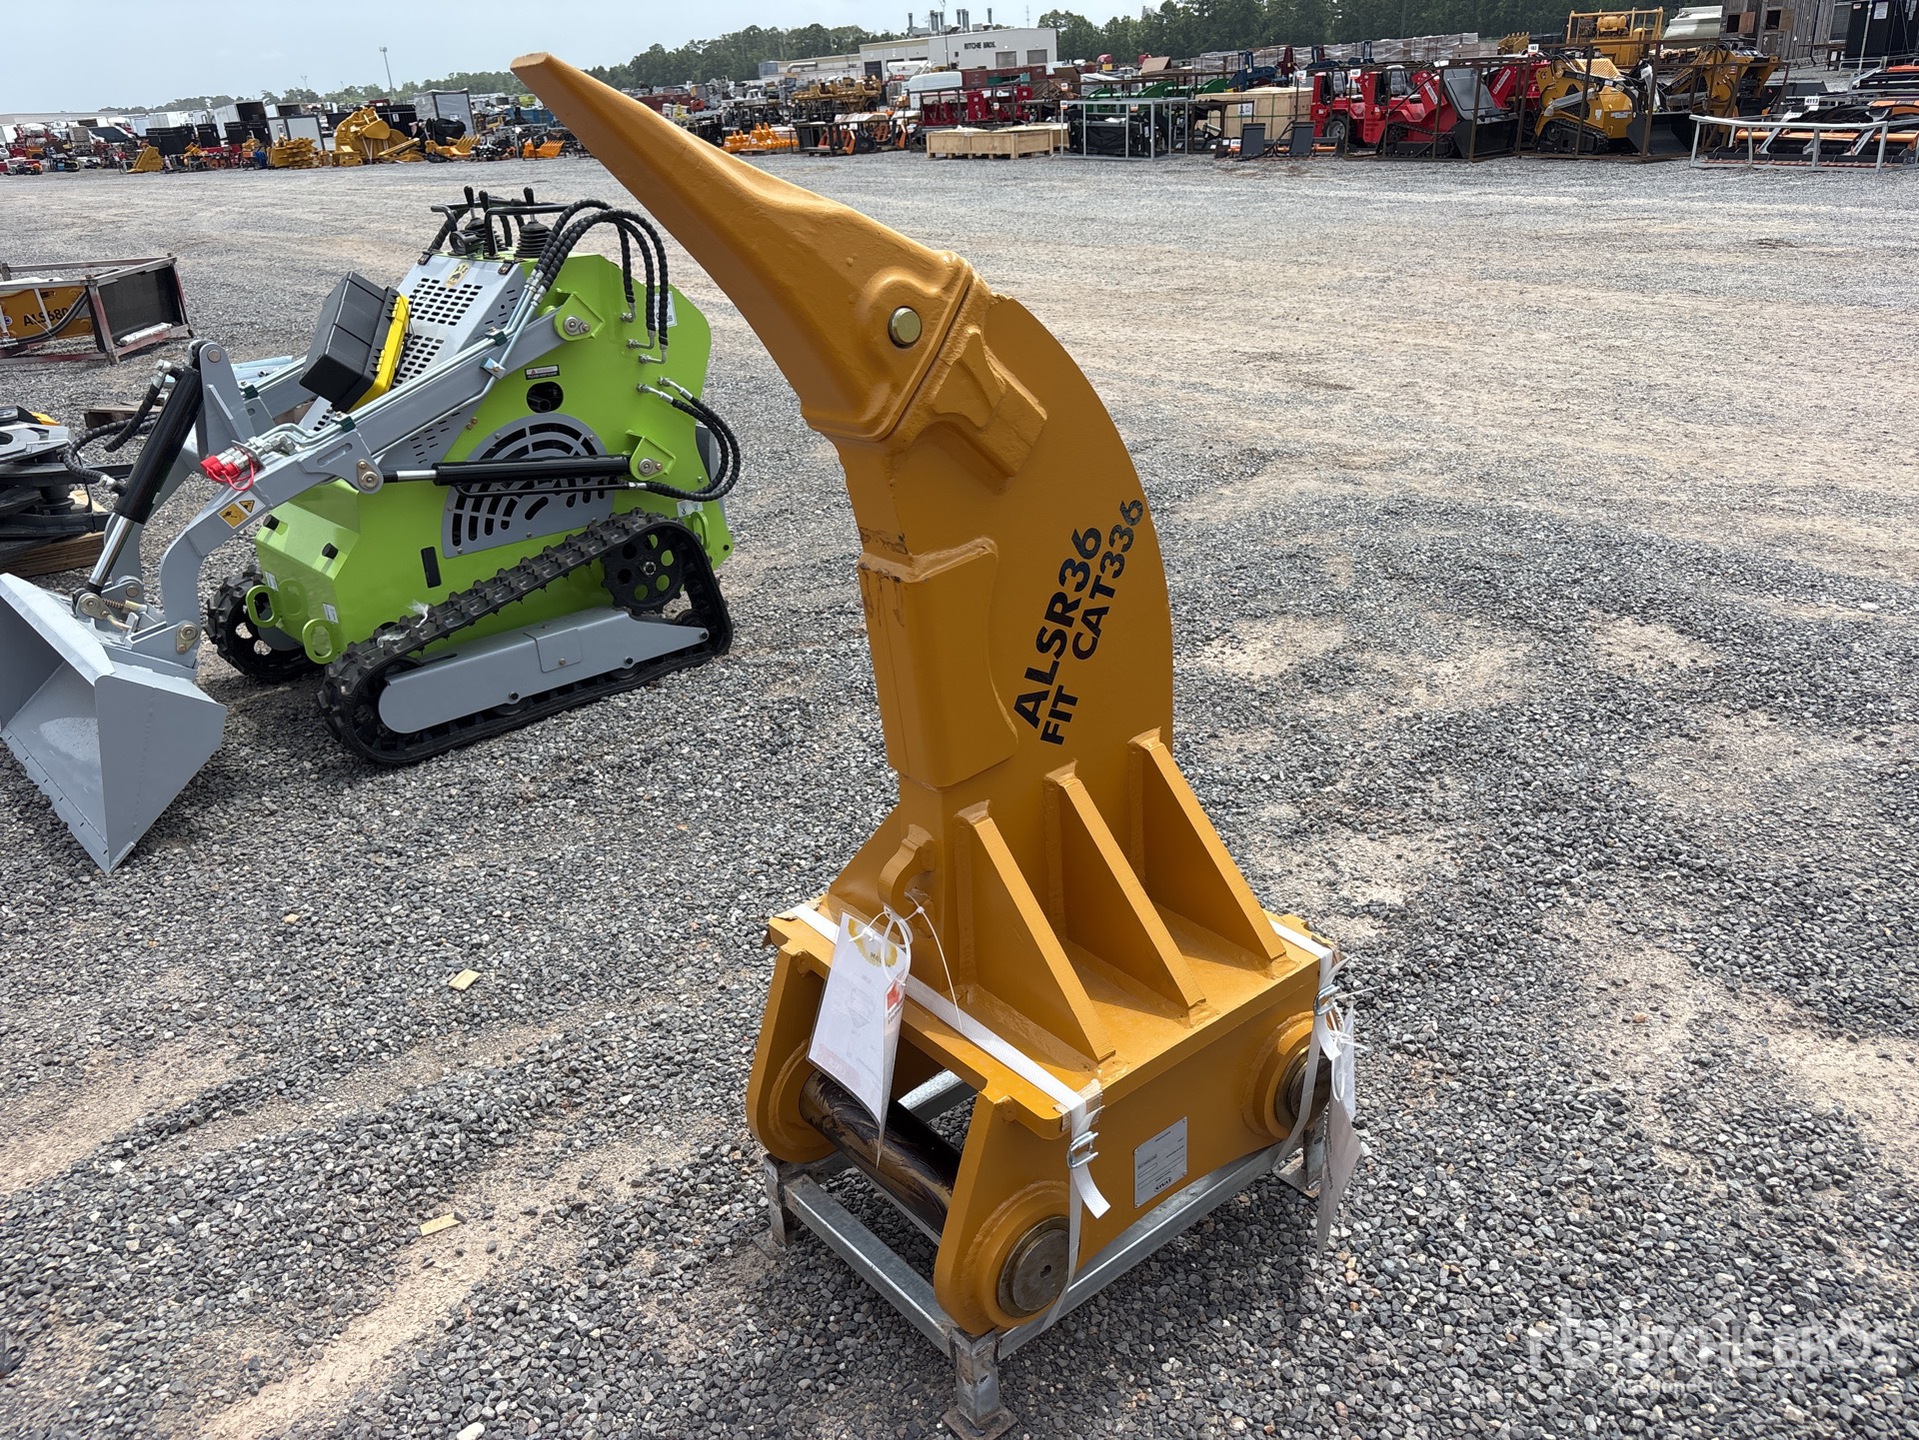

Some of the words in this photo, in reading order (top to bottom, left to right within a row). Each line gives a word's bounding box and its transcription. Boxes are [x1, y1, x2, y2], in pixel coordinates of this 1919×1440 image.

[1013, 527, 1102, 730] ALSR36
[1039, 684, 1078, 746] FIT
[1072, 499, 1144, 661] CAT336
